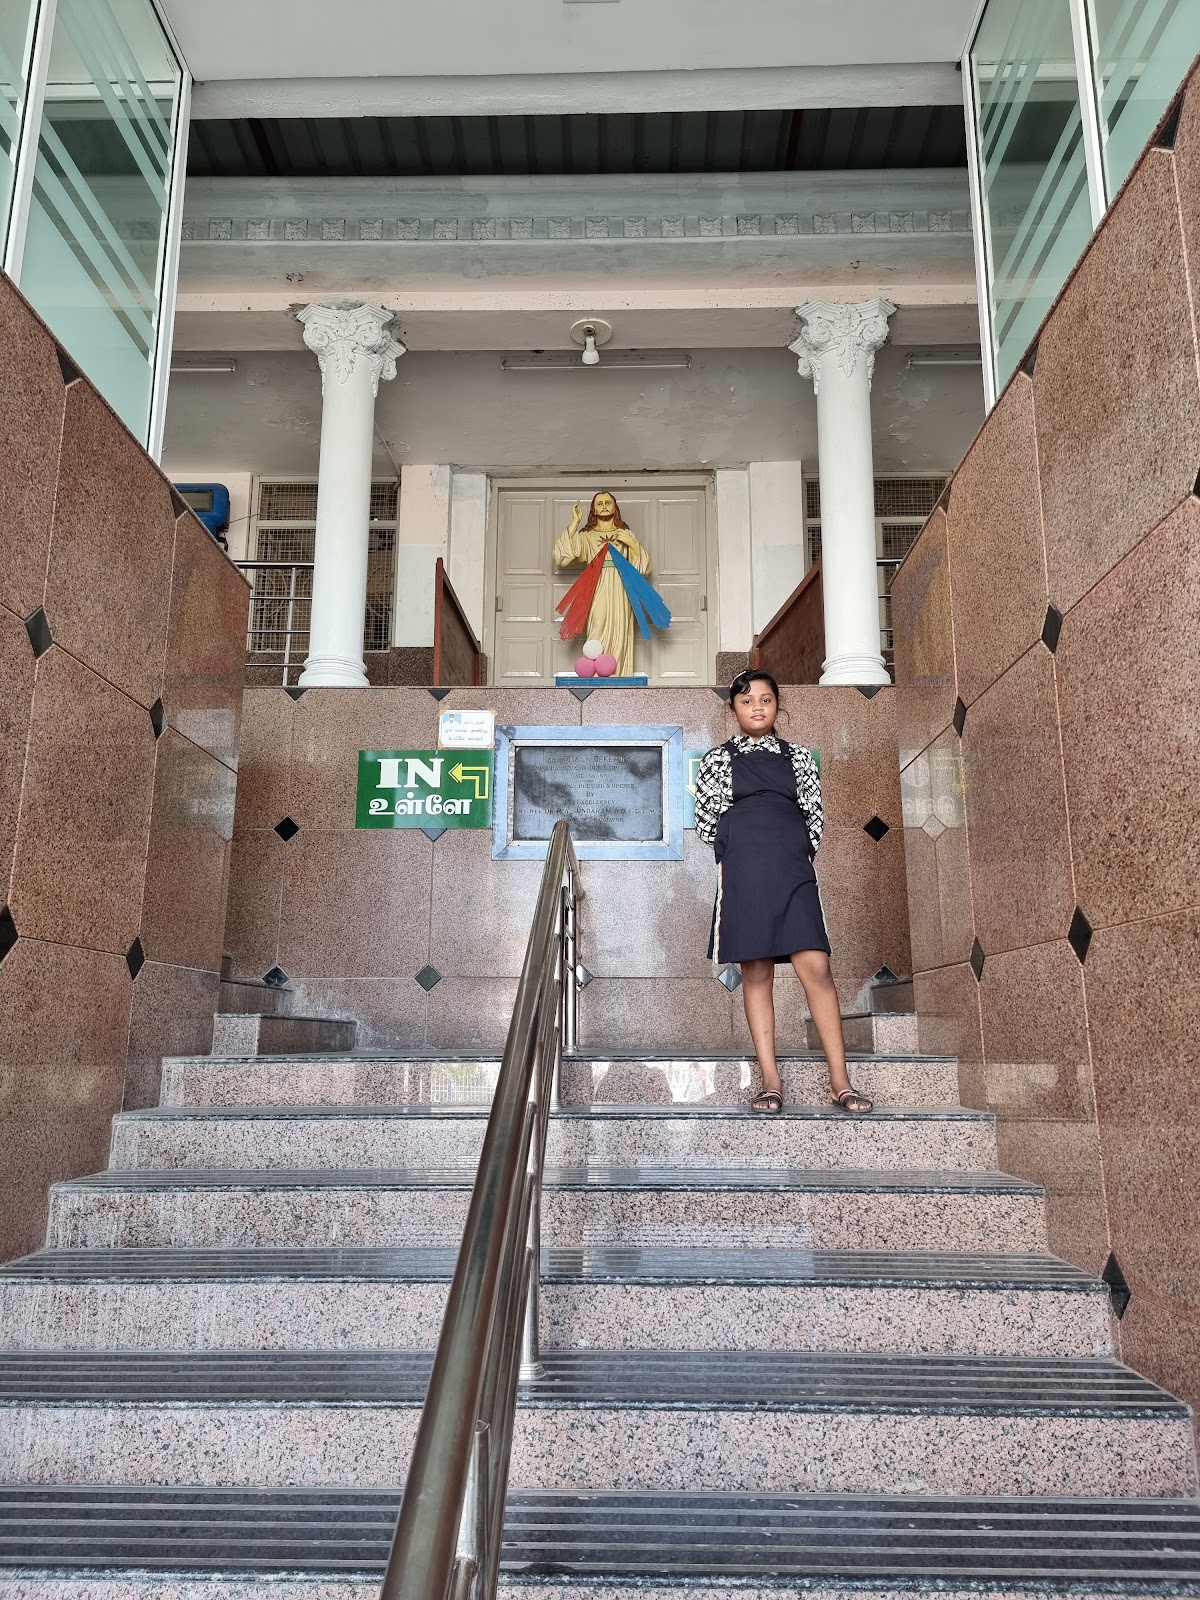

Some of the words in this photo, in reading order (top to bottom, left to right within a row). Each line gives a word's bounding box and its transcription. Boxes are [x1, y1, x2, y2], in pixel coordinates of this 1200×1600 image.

[376, 758, 444, 788] IN
[368, 791, 473, 815] உள்ளே
[571, 807, 611, 815] SUNDARAM
